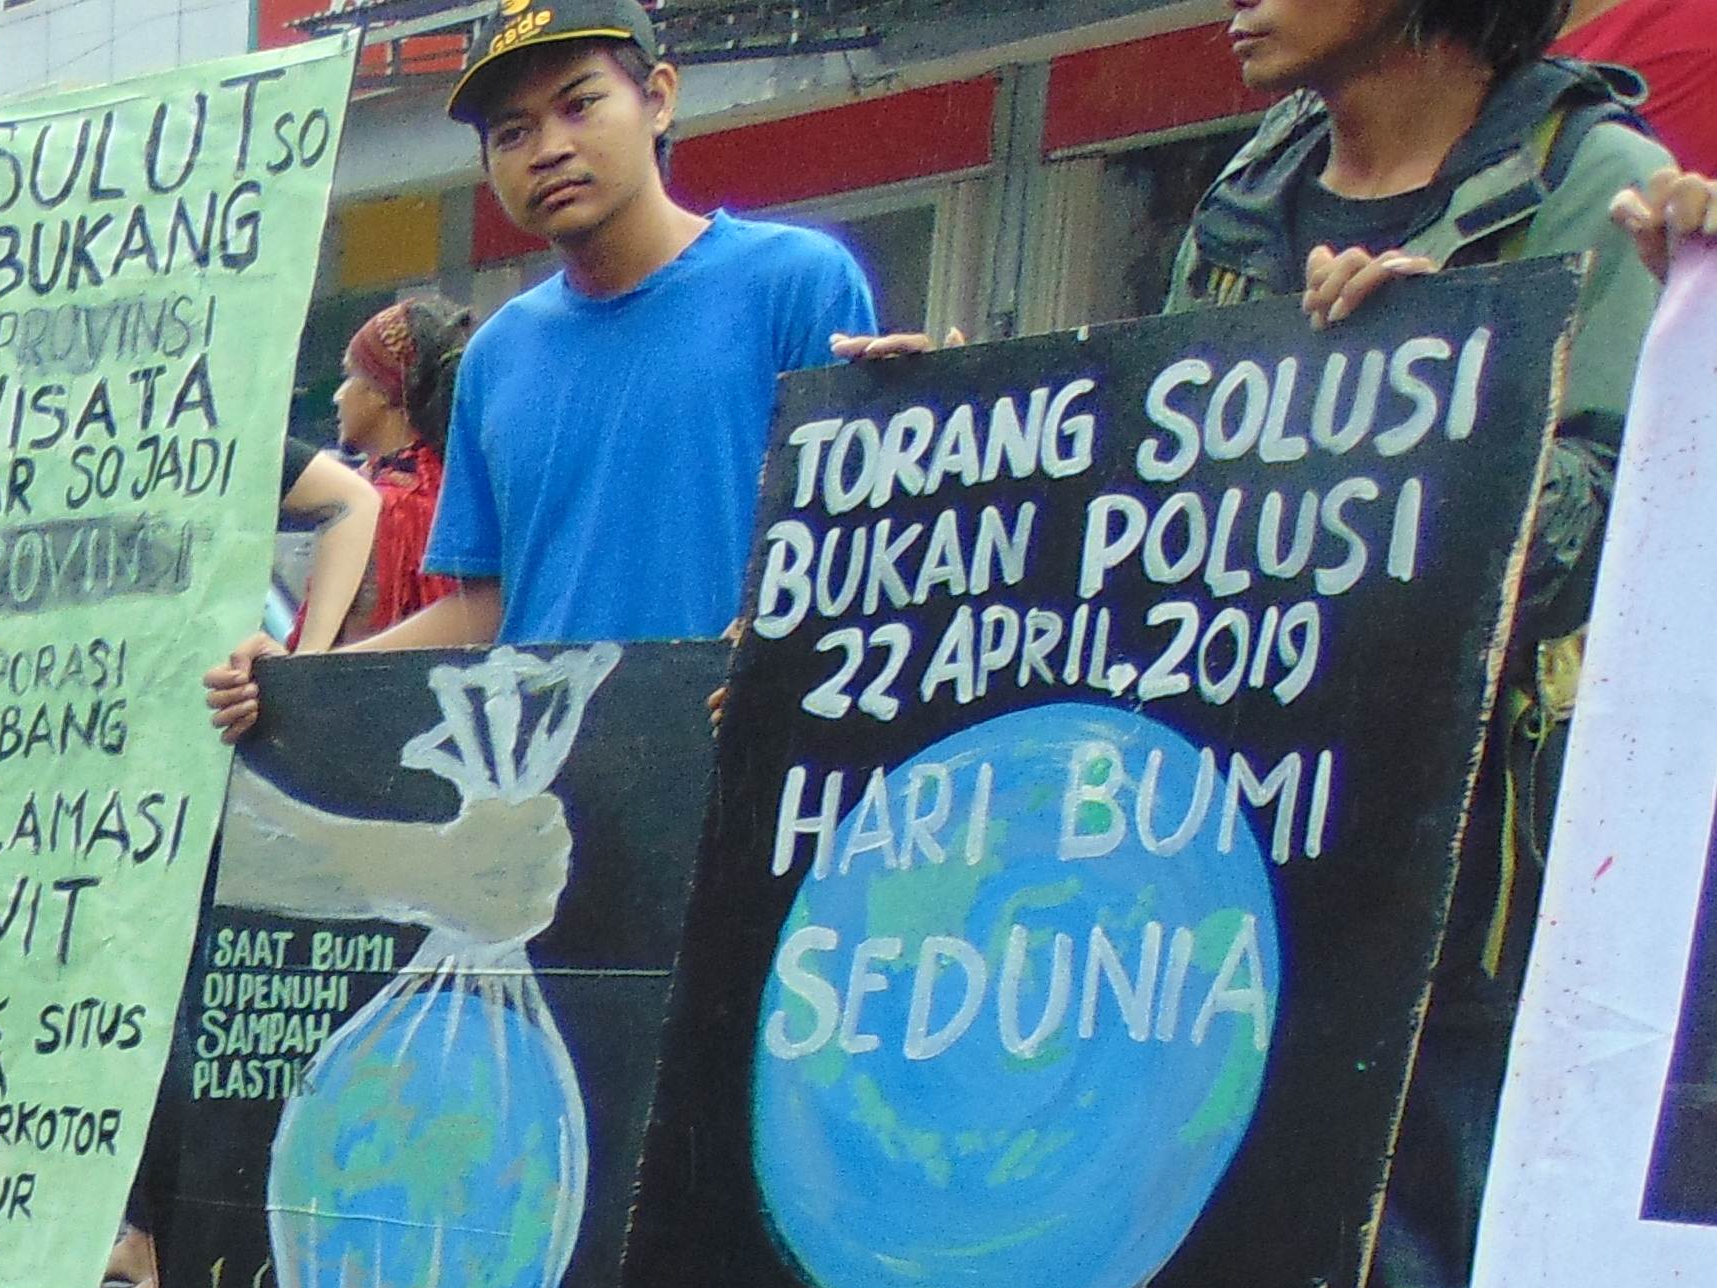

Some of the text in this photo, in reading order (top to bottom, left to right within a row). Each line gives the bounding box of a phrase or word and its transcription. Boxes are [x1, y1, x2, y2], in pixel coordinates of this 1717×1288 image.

[787, 327, 1491, 517] TORANG SOLUSI
[752, 474, 1424, 641] BUKAN POLUSI
[804, 621, 911, 721] 22
[773, 740, 1332, 876] HARI BUMI
[215, 928, 394, 971] SAAT BUMI
[764, 912, 1271, 1062] SEDUNIA
[35, 997, 147, 1054] SITUS
[204, 972, 348, 1012] DIPENUHI
[197, 1009, 331, 1059] SAMPAH
[193, 1058, 315, 1100] PLASTIK
